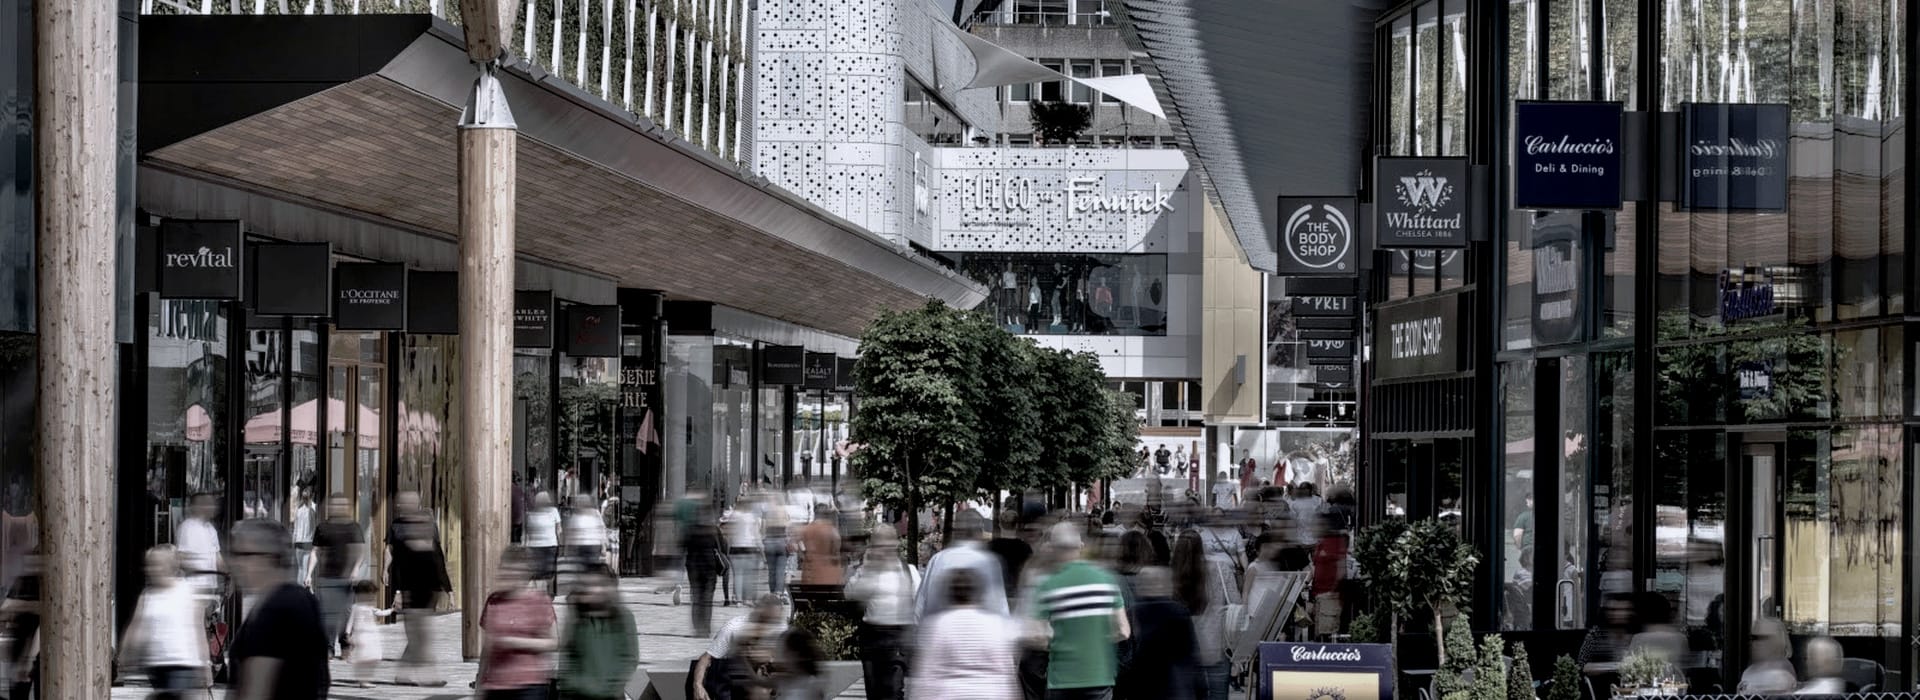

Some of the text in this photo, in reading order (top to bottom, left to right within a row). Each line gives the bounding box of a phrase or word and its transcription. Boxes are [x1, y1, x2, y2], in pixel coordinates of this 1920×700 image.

[1524, 134, 1614, 155] Carluccio's
[1535, 163, 1604, 176] Deli & Dining
[1064, 178, 1176, 221] Fenwick
[1306, 222, 1330, 232] THE
[1386, 212, 1461, 230] Whittard
[1299, 233, 1337, 244] BODY
[166, 246, 234, 268] revital
[1300, 245, 1337, 256] SHOP
[341, 288, 400, 299] L'OCCITANE
[1391, 316, 1442, 359] THE BODY SHOP
[1290, 645, 1362, 662] Carluccio's
